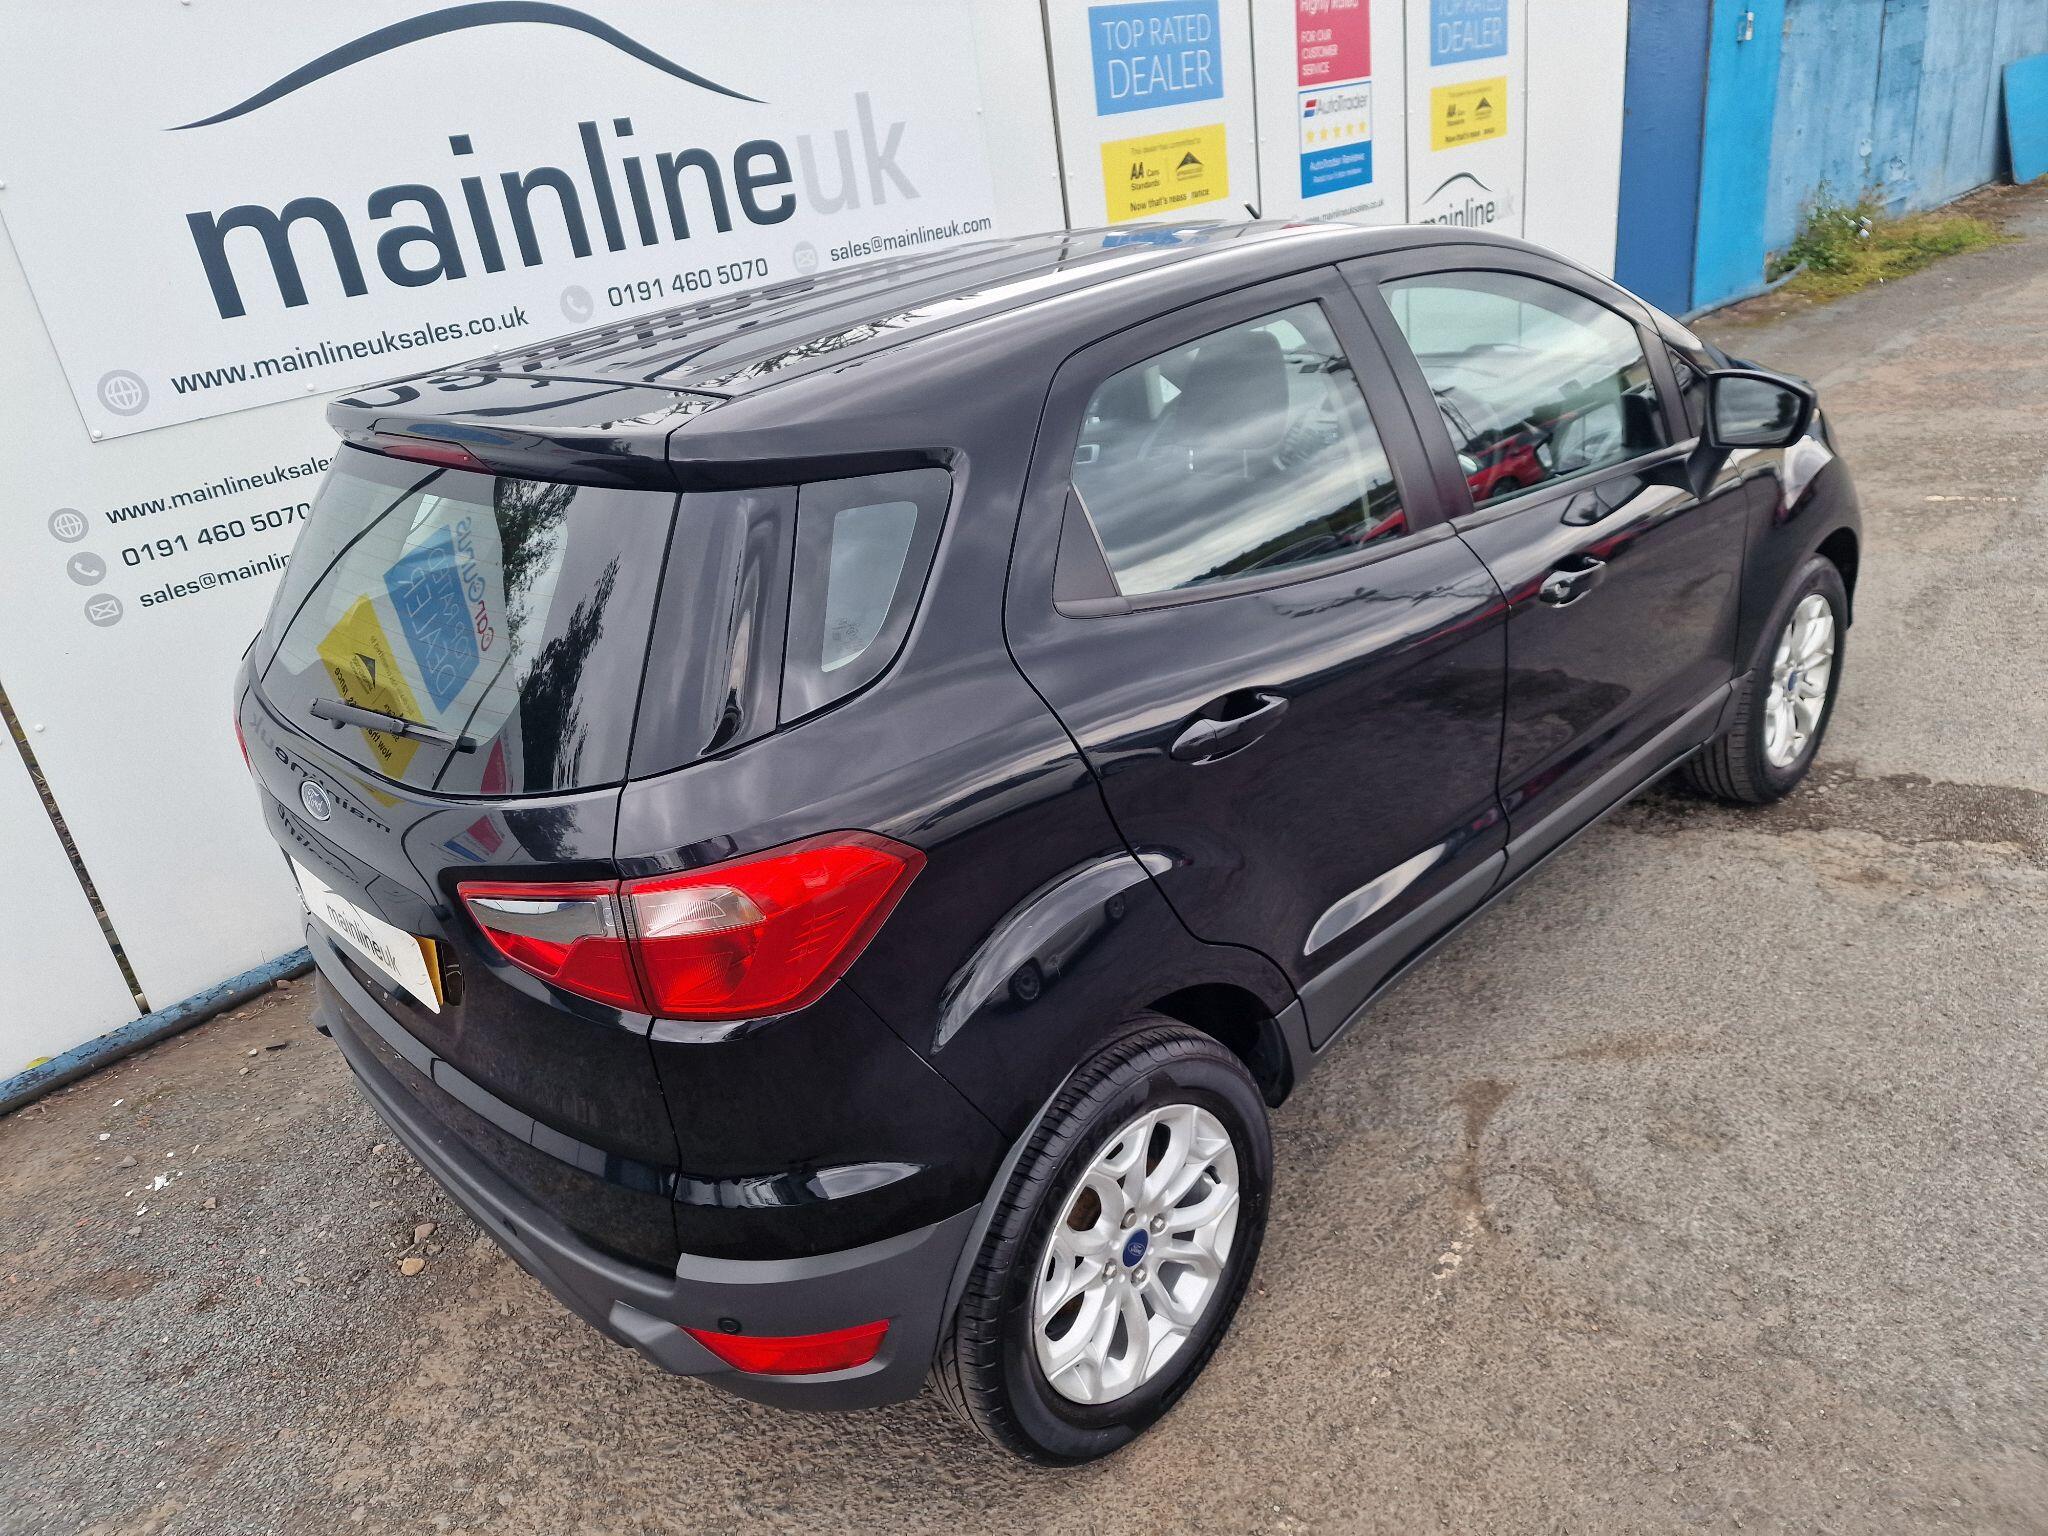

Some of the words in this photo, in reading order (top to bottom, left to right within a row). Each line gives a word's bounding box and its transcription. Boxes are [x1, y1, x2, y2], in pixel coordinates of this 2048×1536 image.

[1102, 19, 1144, 50] TOP
[1150, 13, 1212, 45] RATED
[1108, 49, 1214, 98] DEALER
[186, 92, 920, 319] mainlineuk
[830, 217, 992, 262] sales@mainlineuk.com
[607, 277, 664, 307] 0191
[671, 268, 712, 293] 460
[717, 257, 769, 285] 5070
[170, 305, 530, 394] www.mainlineuksales.co.uk
[121, 534, 189, 567] 0191
[197, 520, 246, 546] 460
[250, 502, 311, 532] 5070
[325, 903, 402, 977] mainlineuk
